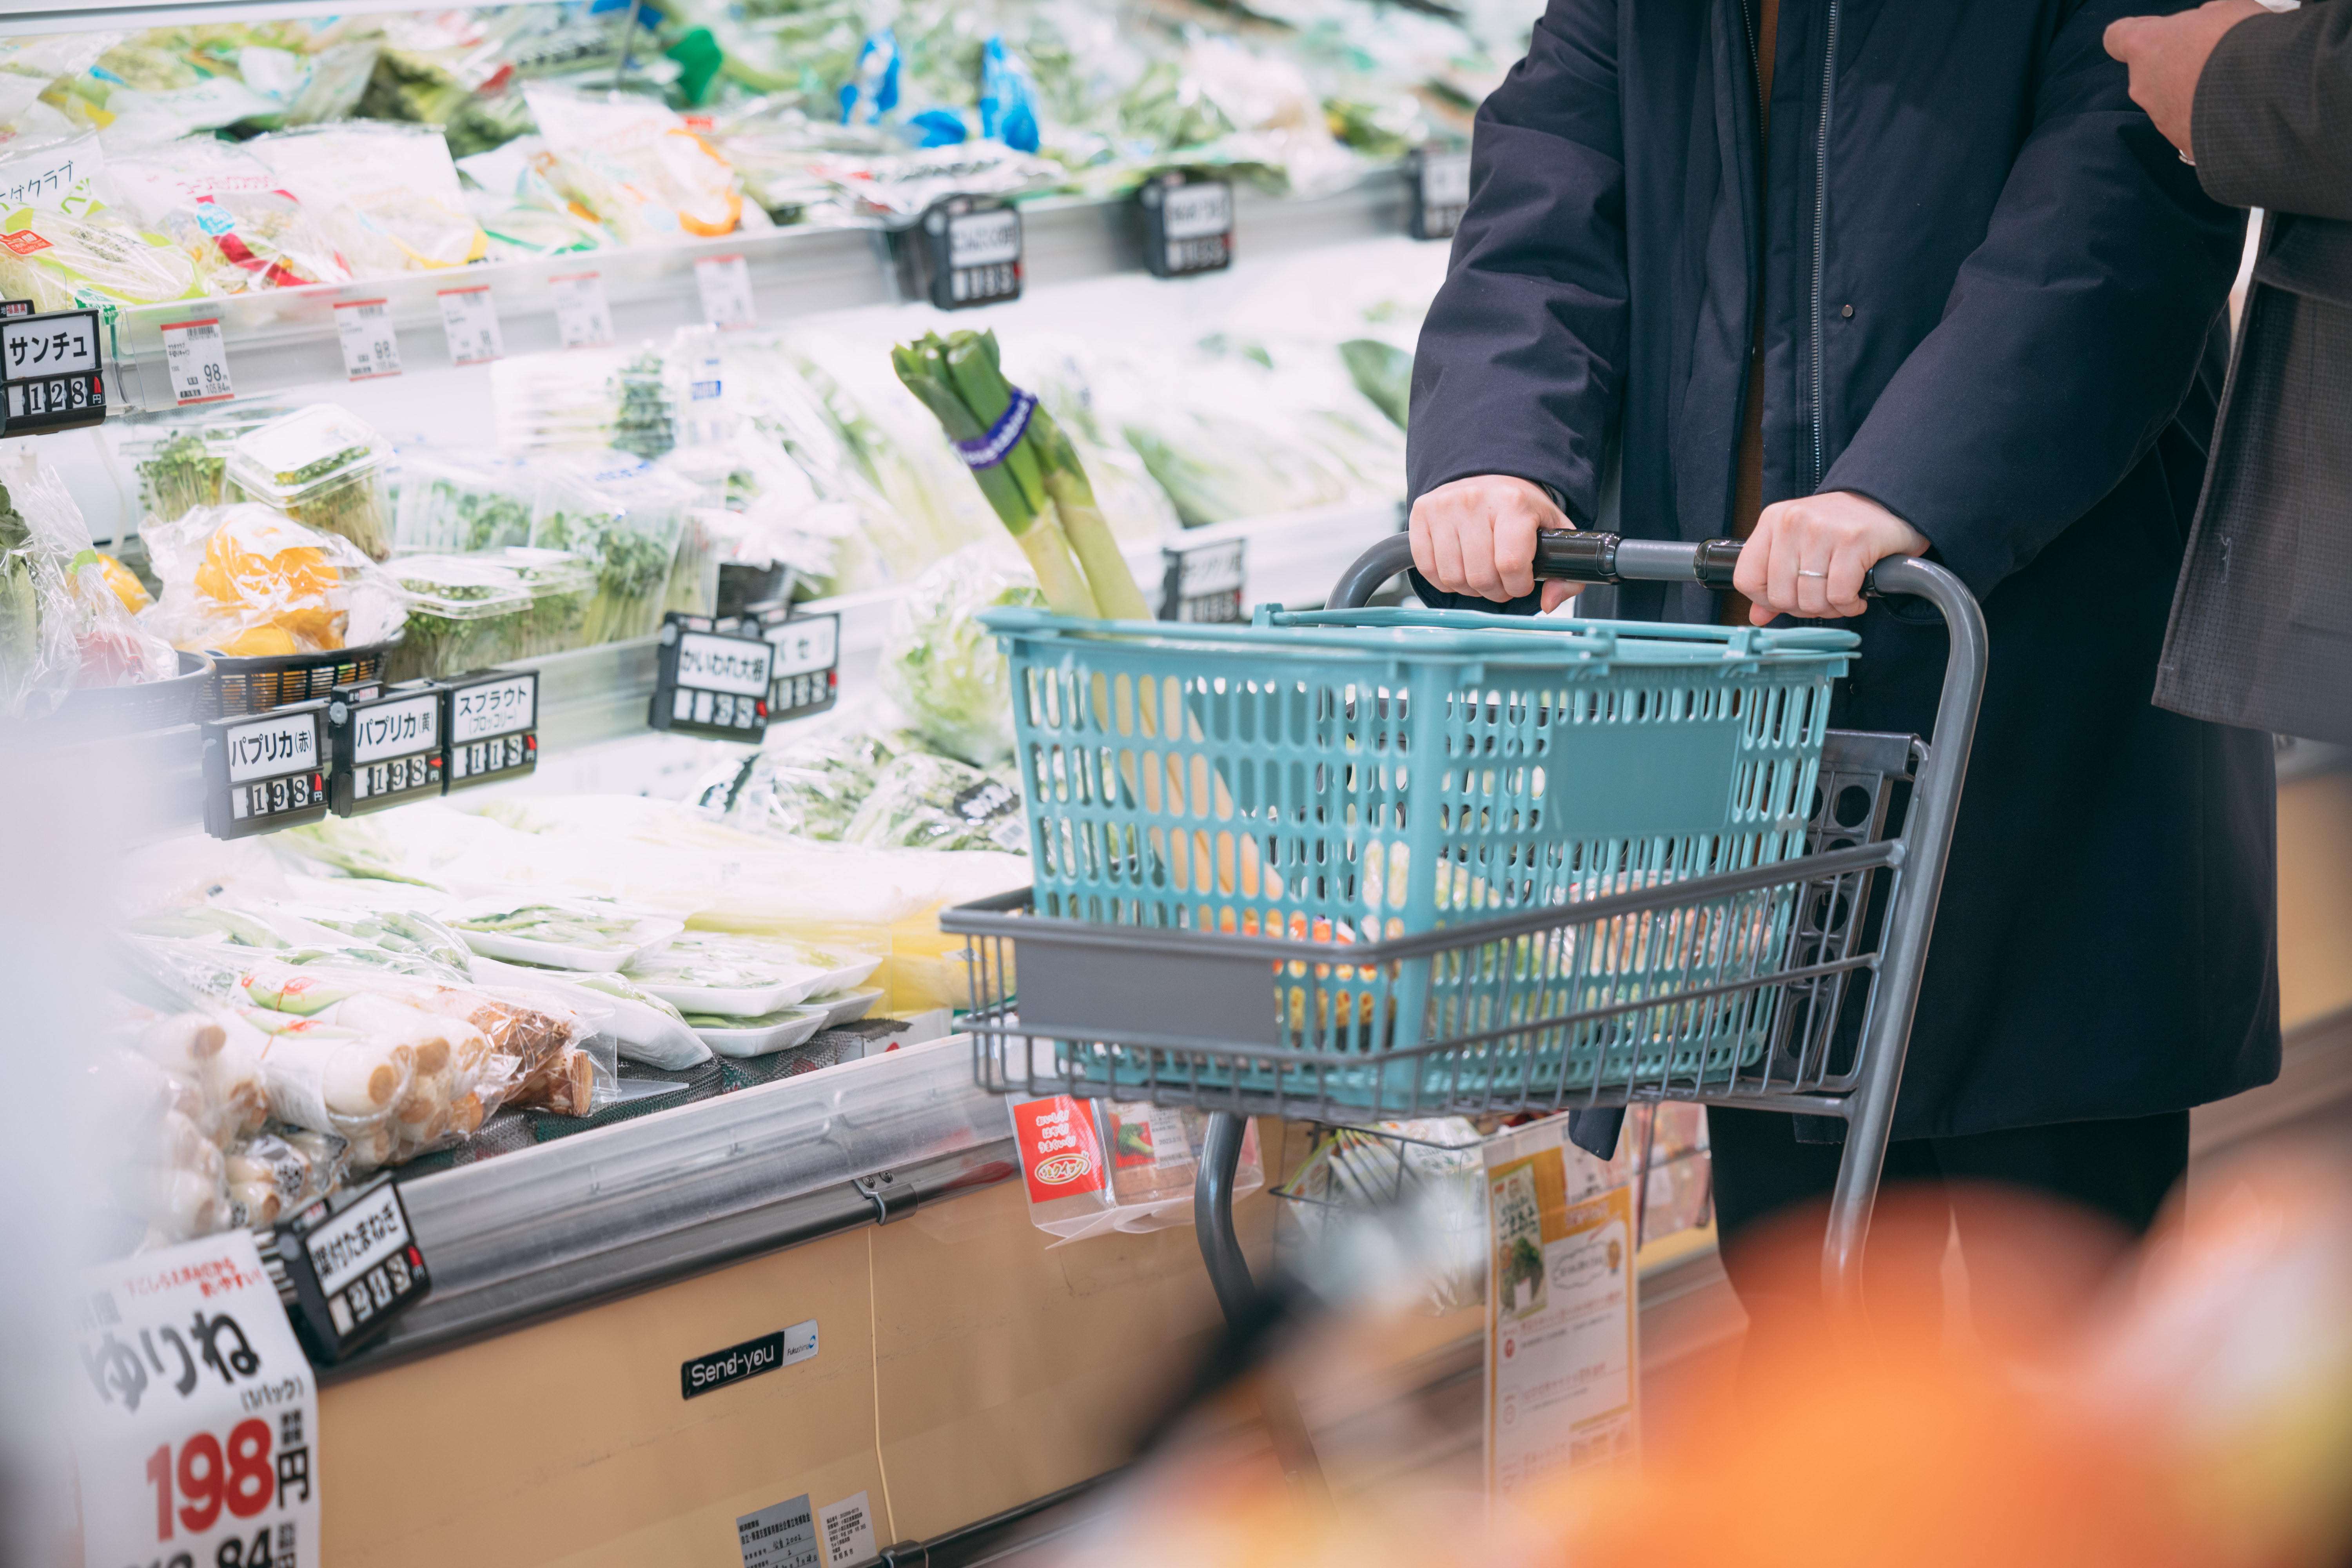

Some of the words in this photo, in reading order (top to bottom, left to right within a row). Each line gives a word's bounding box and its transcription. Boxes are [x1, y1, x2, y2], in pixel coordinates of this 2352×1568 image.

[0, 160, 73, 202] ダクラブ
[7, 304, 26, 314] 福島県
[9, 332, 87, 366] サンチュ
[459, 685, 526, 717] スプラウト
[357, 711, 433, 748] パプリカ(黄)
[231, 730, 312, 768] パプリカ(赤)
[80, 1311, 261, 1414] ゆりね
[692, 1345, 774, 1387] Send-you
[788, 1344, 809, 1356] Fukushima
